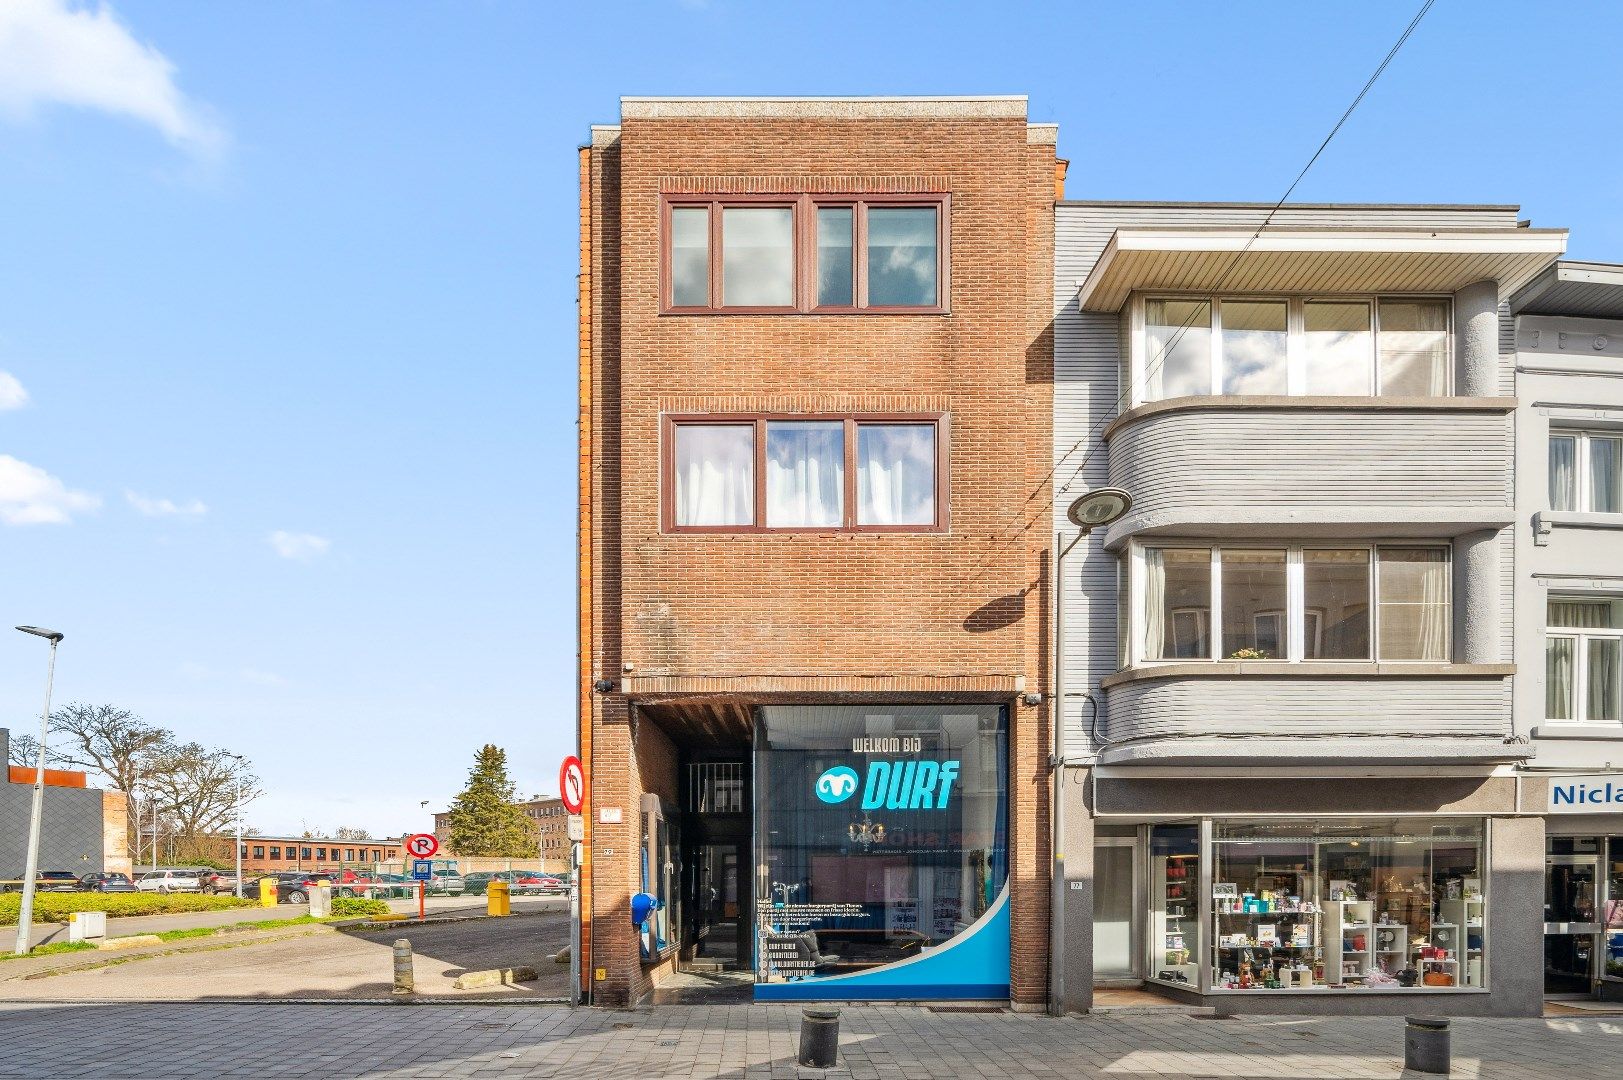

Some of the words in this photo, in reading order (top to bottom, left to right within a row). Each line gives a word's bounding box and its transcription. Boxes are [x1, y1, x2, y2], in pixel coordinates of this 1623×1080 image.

[853, 738, 899, 752] WELKOM
[904, 738, 921, 752] BIJ
[1554, 783, 1623, 804] Nicla
